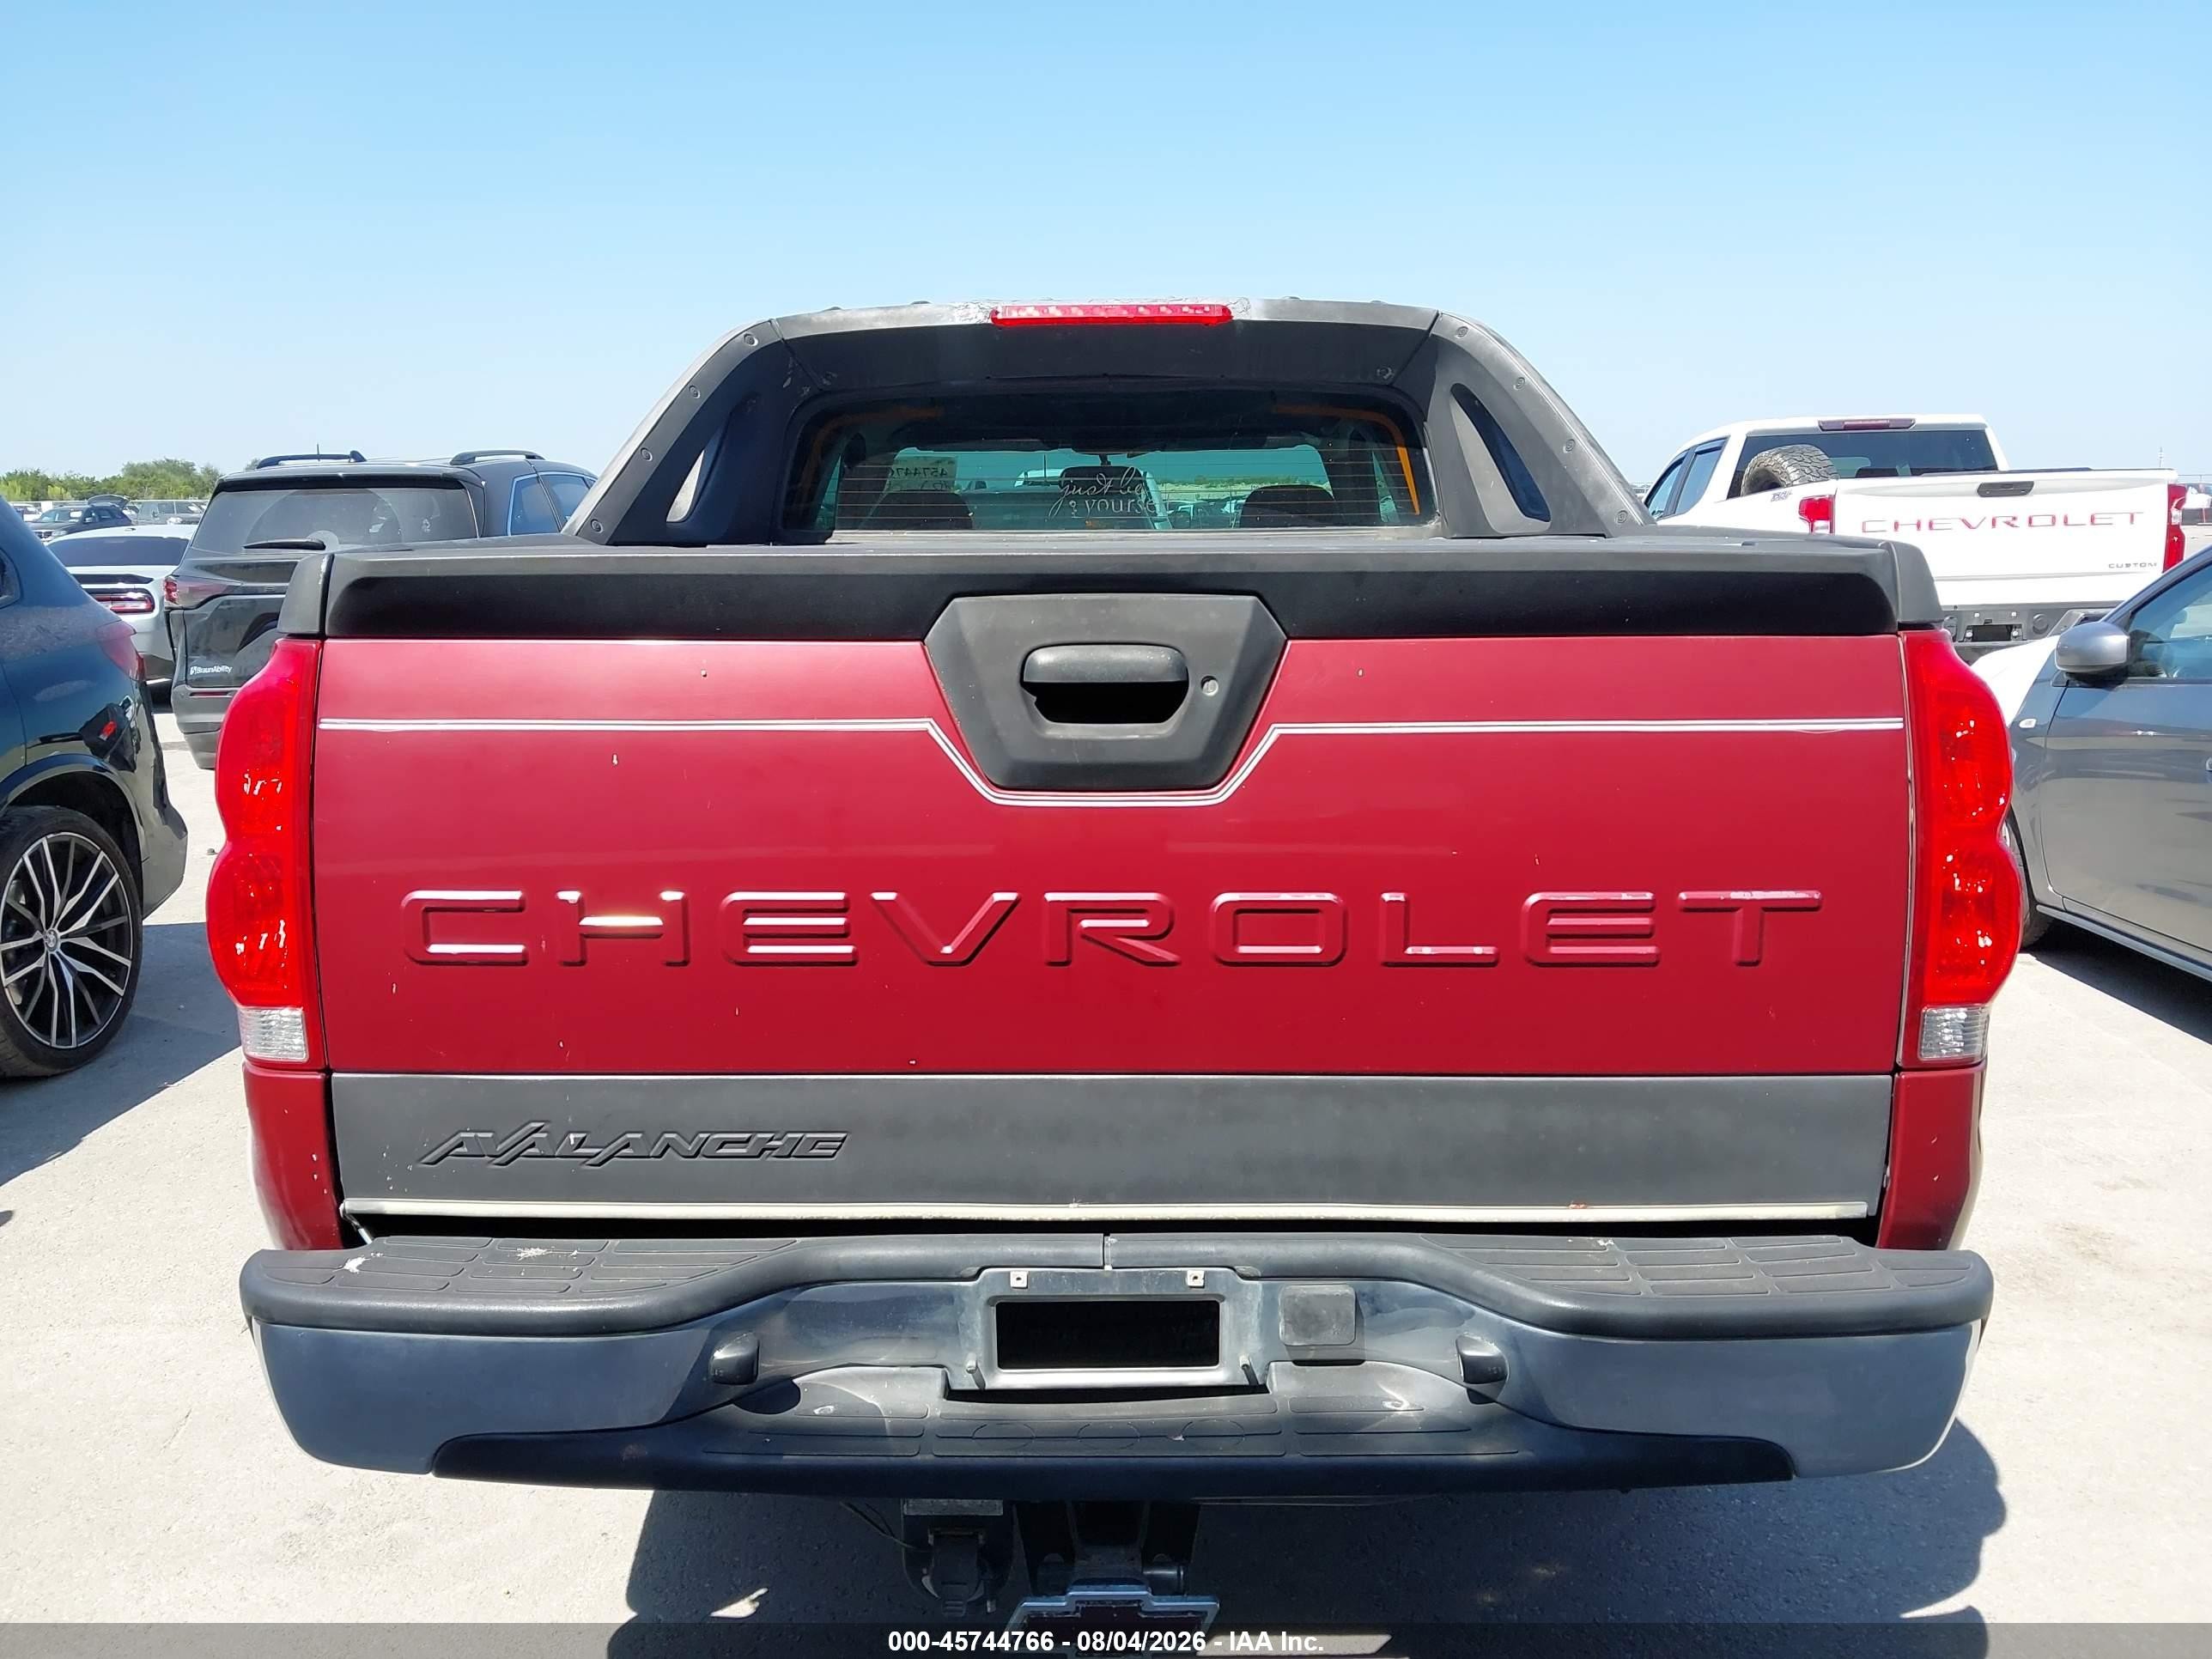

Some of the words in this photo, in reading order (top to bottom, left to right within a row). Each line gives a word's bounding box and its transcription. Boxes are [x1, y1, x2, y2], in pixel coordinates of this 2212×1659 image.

[1044, 473, 1113, 520] just
[1085, 493, 1171, 518] yourse
[1862, 511, 2144, 533] CHEVROLET
[400, 888, 1823, 969] CHEVROLET
[420, 1120, 850, 1168] AVALANCHE
